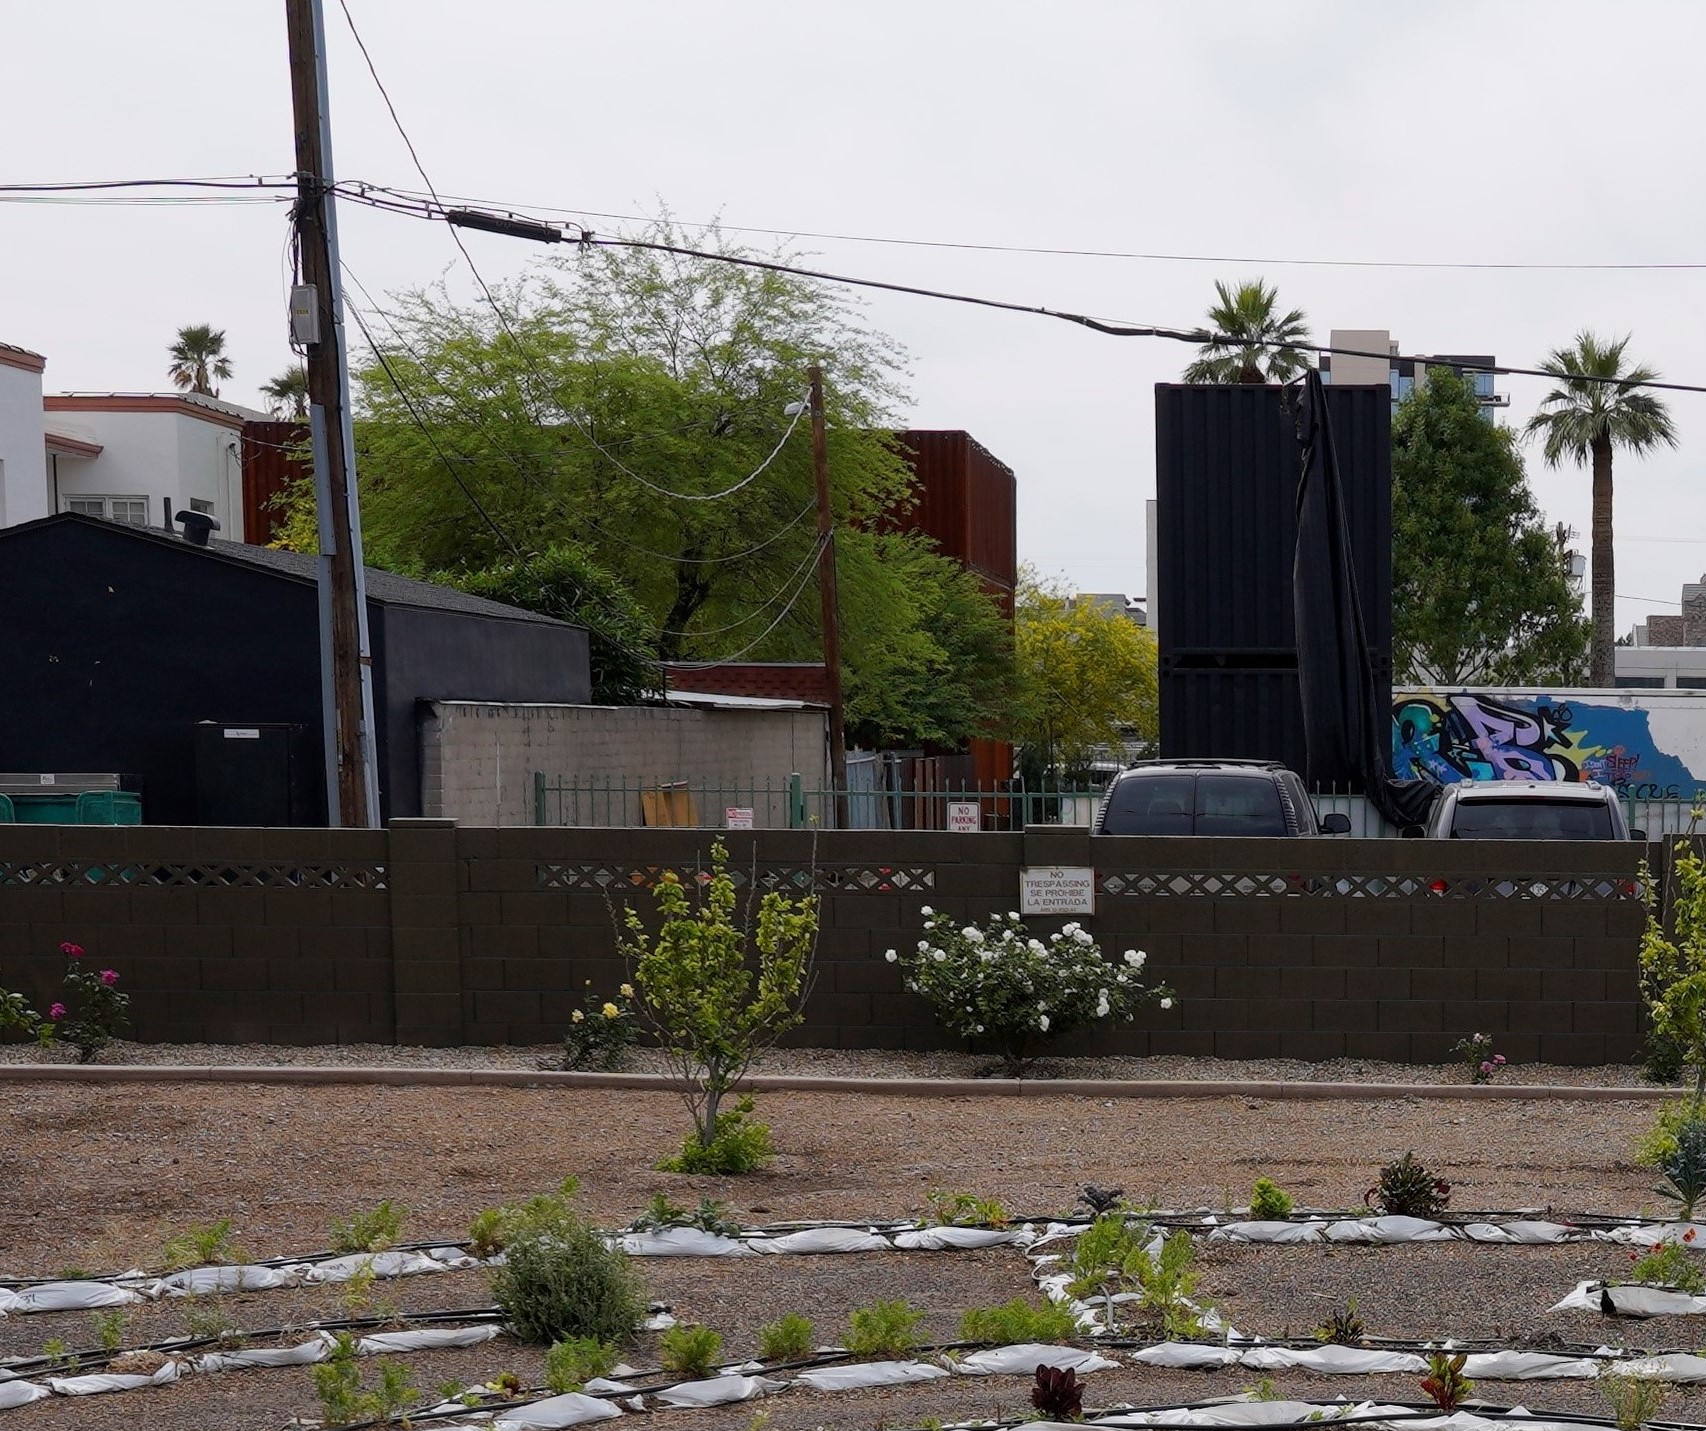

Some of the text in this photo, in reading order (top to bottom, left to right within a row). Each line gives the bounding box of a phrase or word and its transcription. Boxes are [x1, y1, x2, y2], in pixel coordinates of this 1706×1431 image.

[958, 806, 970, 815] NO
[951, 816, 977, 825] PARKING
[1050, 871, 1064, 879] NO
[1025, 880, 1090, 888] TRESPASSING
[1030, 889, 1086, 897] SE PROHIBE
[1027, 898, 1088, 906] LA ENTRADA
